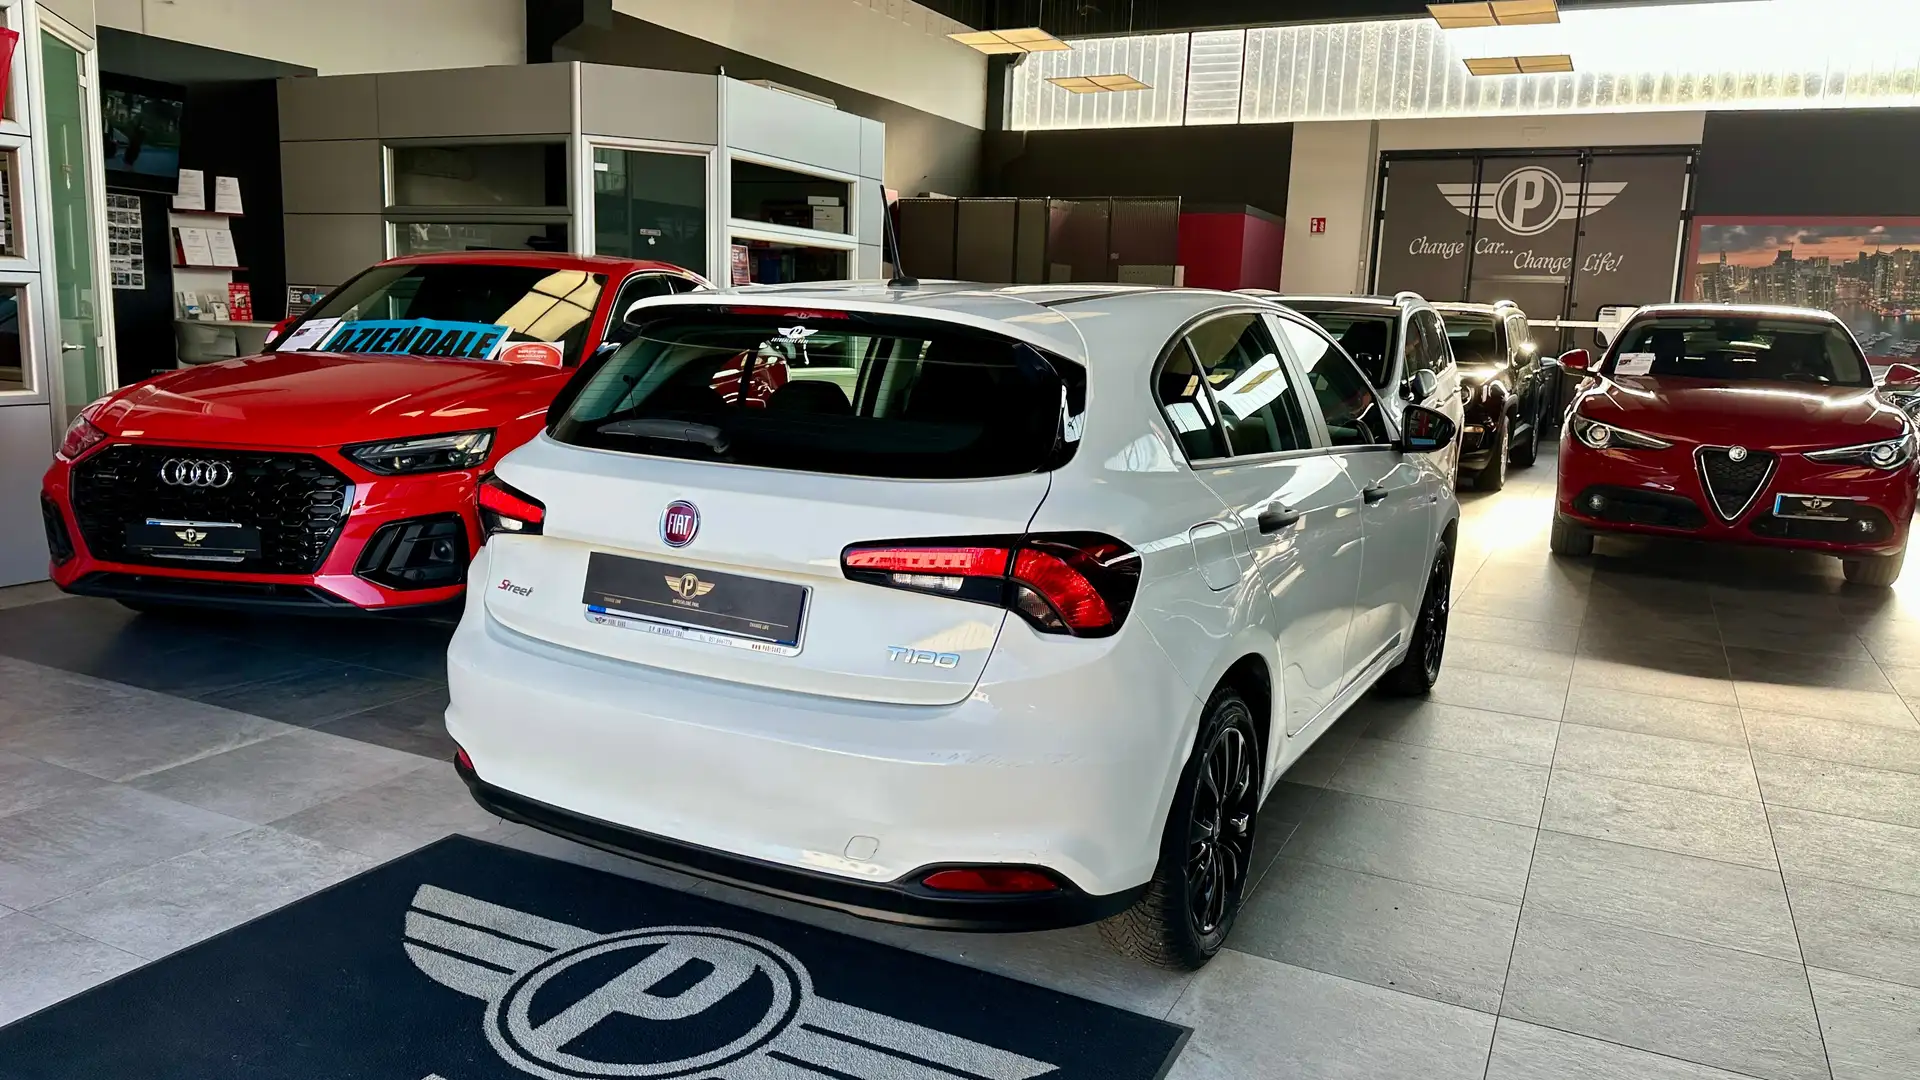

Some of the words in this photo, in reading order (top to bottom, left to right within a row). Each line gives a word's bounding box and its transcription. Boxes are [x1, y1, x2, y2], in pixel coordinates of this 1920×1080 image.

[1512, 170, 1545, 228] P
[1409, 235, 1464, 259] Change
[1475, 237, 1514, 255] Car...
[1513, 251, 1571, 274] Change
[1580, 252, 1624, 276] Life!
[329, 326, 494, 358] AZIENDALE
[667, 513, 692, 536] FIAT
[498, 579, 534, 597] Street
[886, 645, 961, 669] TIPO
